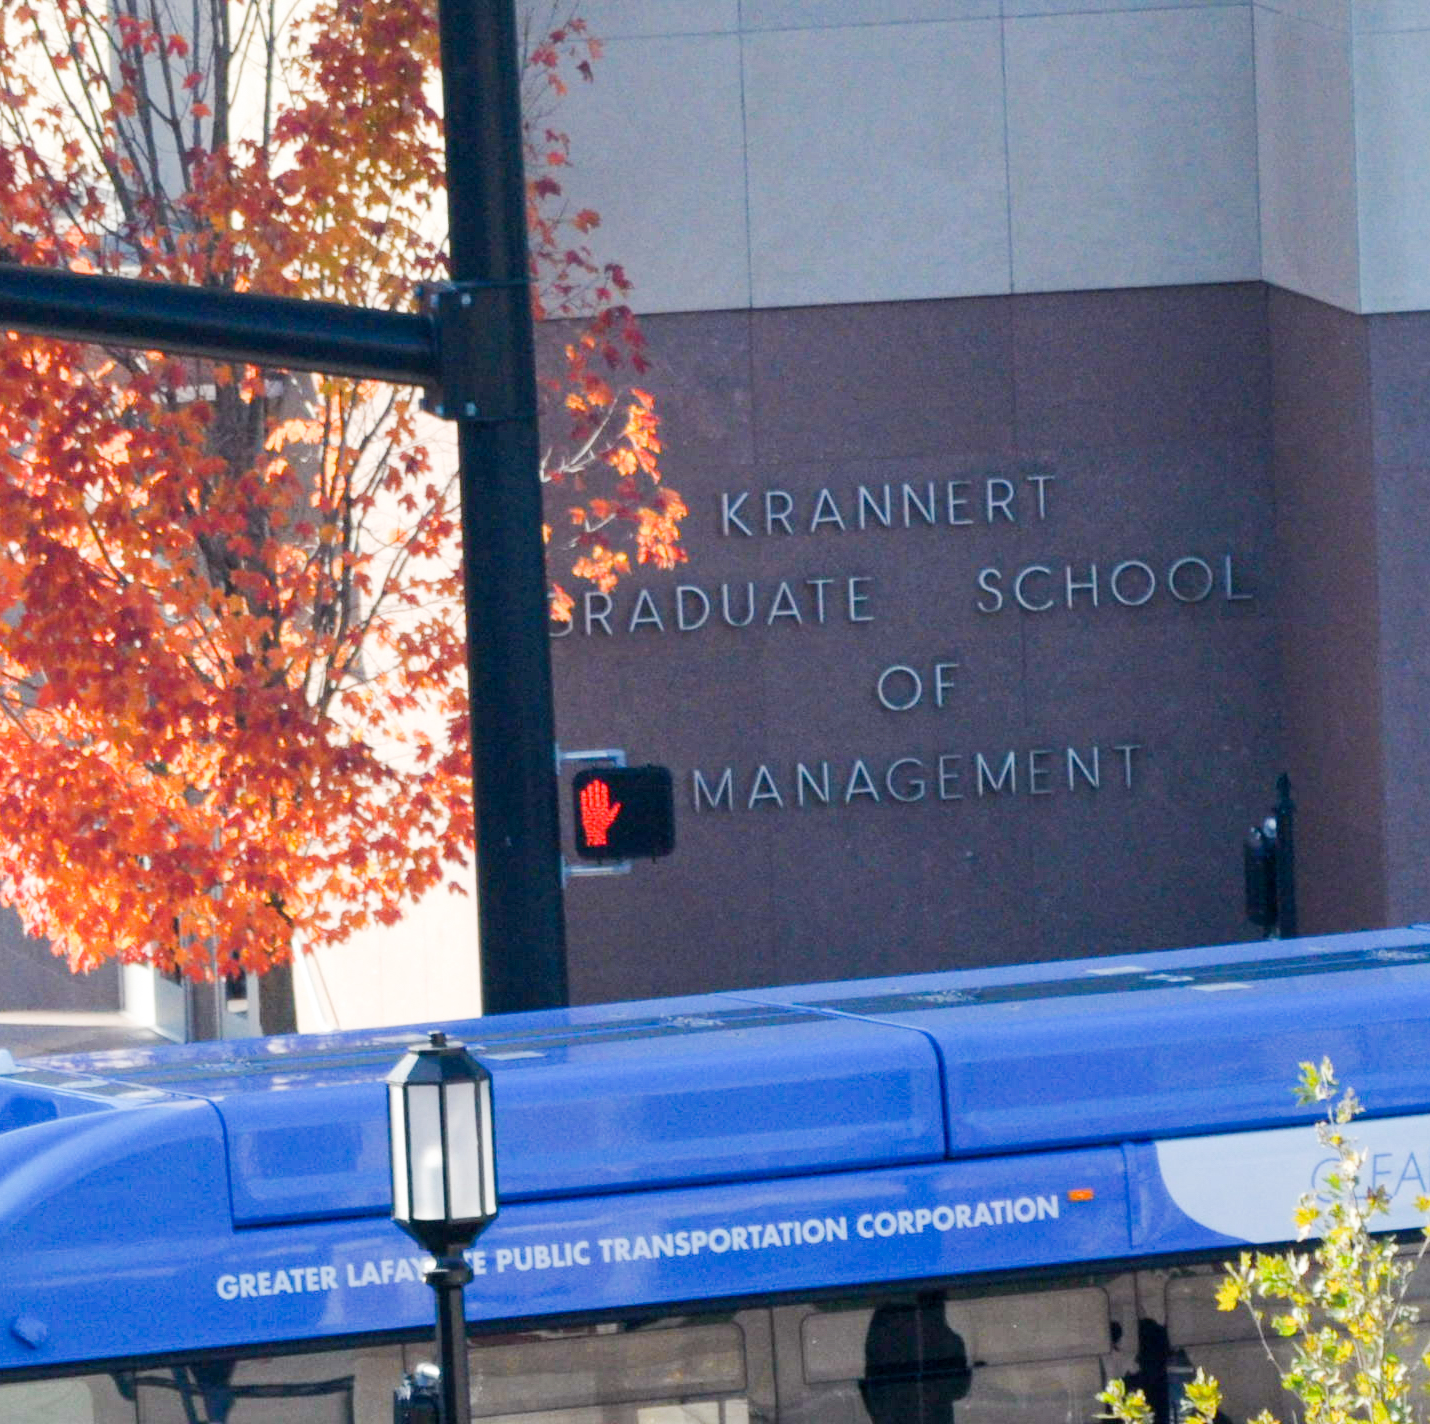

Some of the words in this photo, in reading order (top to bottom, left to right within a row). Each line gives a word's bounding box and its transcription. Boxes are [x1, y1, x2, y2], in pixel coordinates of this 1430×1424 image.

[720, 475, 1056, 536] KRANNERT
[975, 555, 1255, 615] SCHOOL
[877, 663, 960, 711] OF
[691, 745, 1144, 813] MANAGEMENT
[216, 1266, 339, 1301] GREATER
[347, 1250, 488, 1288] LAFAYE
[497, 1240, 591, 1273] PUBLIC
[598, 1216, 849, 1264] TRANSPORTATION
[857, 1194, 1060, 1239] CORPORATION
